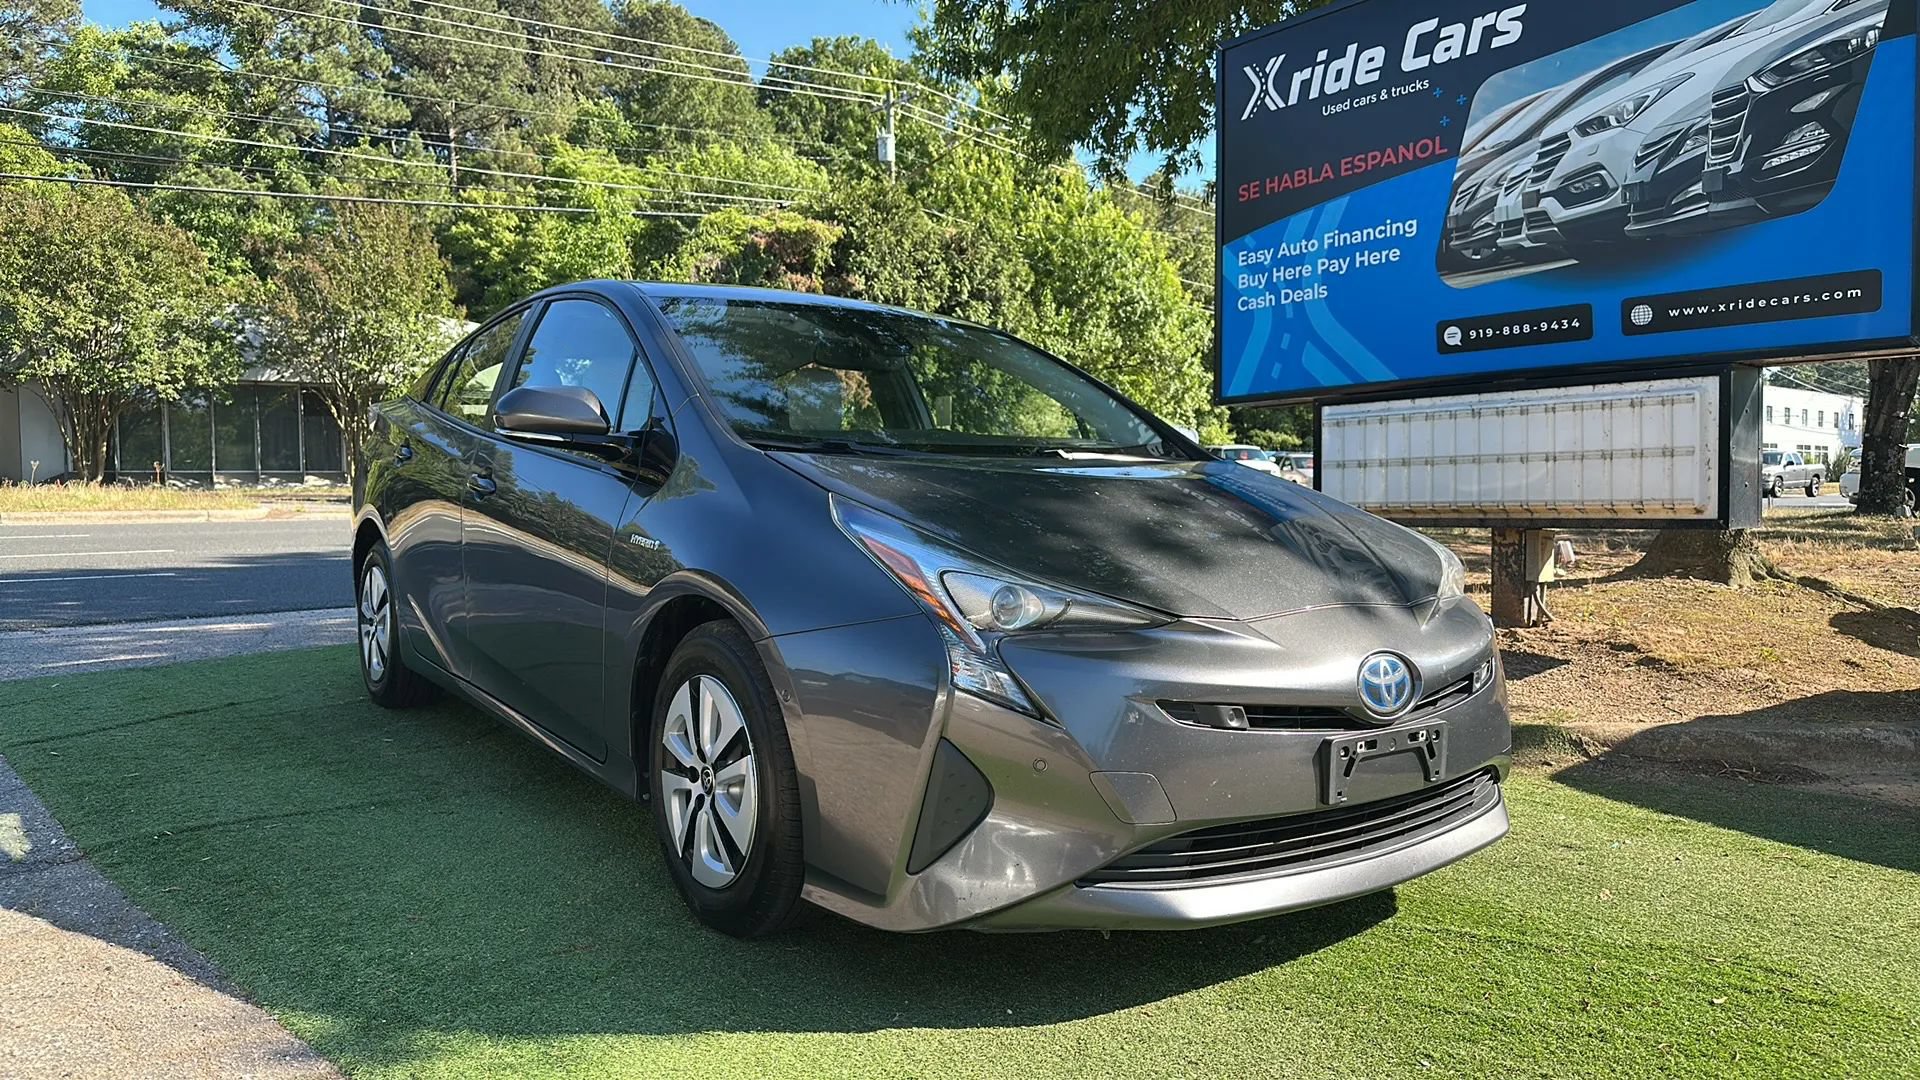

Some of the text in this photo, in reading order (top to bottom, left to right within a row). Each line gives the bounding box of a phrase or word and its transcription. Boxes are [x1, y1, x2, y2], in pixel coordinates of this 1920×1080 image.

[1241, 3, 1527, 120] Xride Cars
[1322, 79, 1430, 116] Used cars & trucks
[1238, 135, 1448, 202] SE HABLA ESPANOL
[1238, 218, 1418, 267] Easy Auto Financing
[1238, 247, 1400, 291] Buy Here Pay Here
[1237, 283, 1328, 312] Cash Deals
[1668, 287, 1863, 318] www.xridecars.com
[1469, 318, 1581, 340] 919-888-9434
